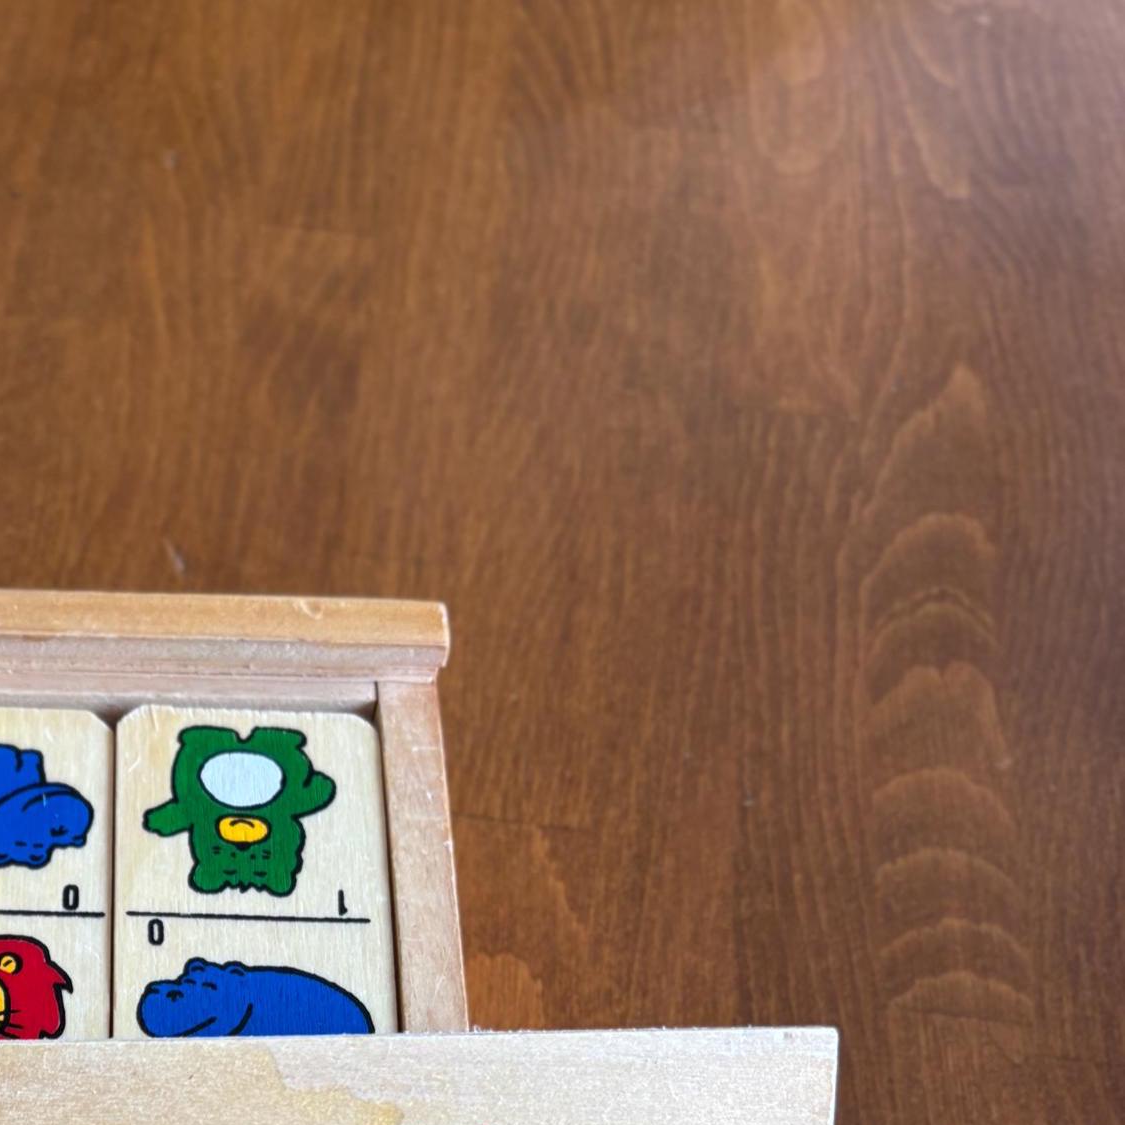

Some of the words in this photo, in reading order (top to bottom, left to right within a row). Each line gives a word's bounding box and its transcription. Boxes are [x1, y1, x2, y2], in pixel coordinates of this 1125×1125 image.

[62, 884, 80, 910] 0
[337, 889, 348, 917] 1
[147, 918, 165, 946] 0
